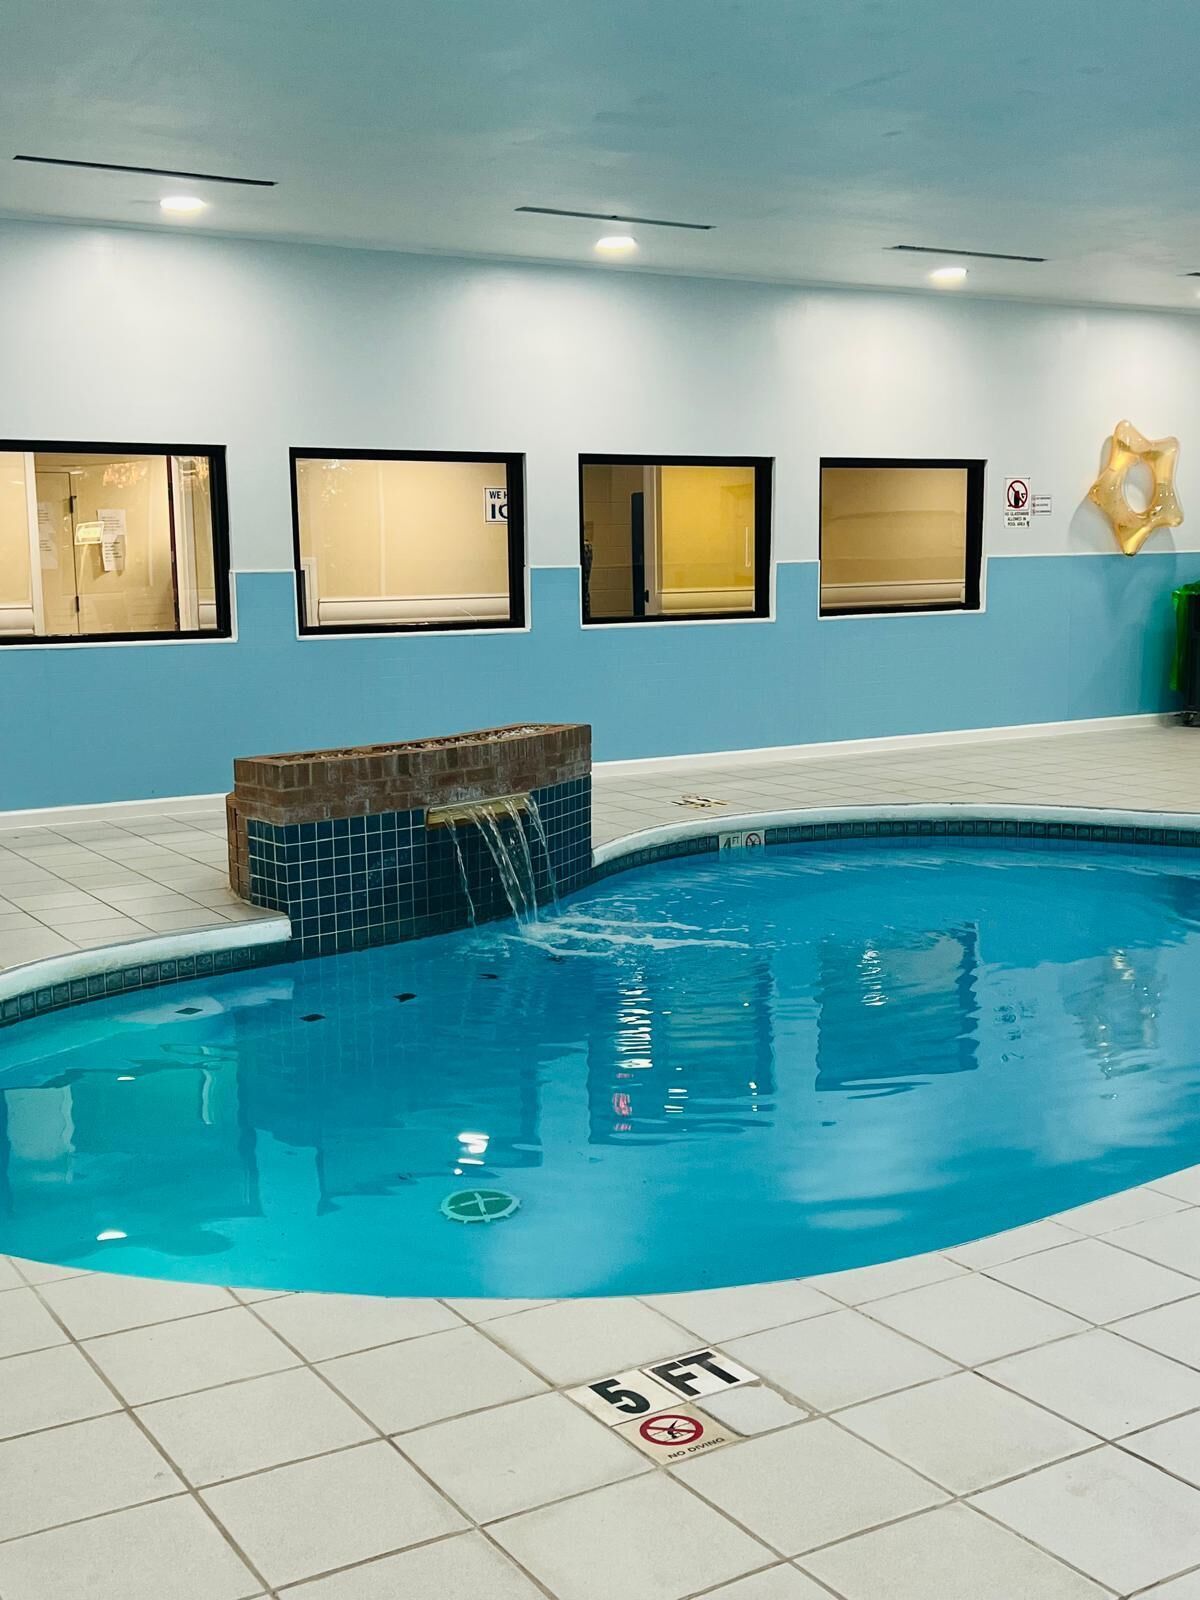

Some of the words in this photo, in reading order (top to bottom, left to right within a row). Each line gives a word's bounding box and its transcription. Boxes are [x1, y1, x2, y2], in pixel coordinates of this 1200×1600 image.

[489, 490, 502, 499] WE
[588, 1378, 651, 1414] 5
[649, 1351, 741, 1397] FT
[667, 1450, 686, 1459] NO
[687, 1437, 725, 1452] DIVING
